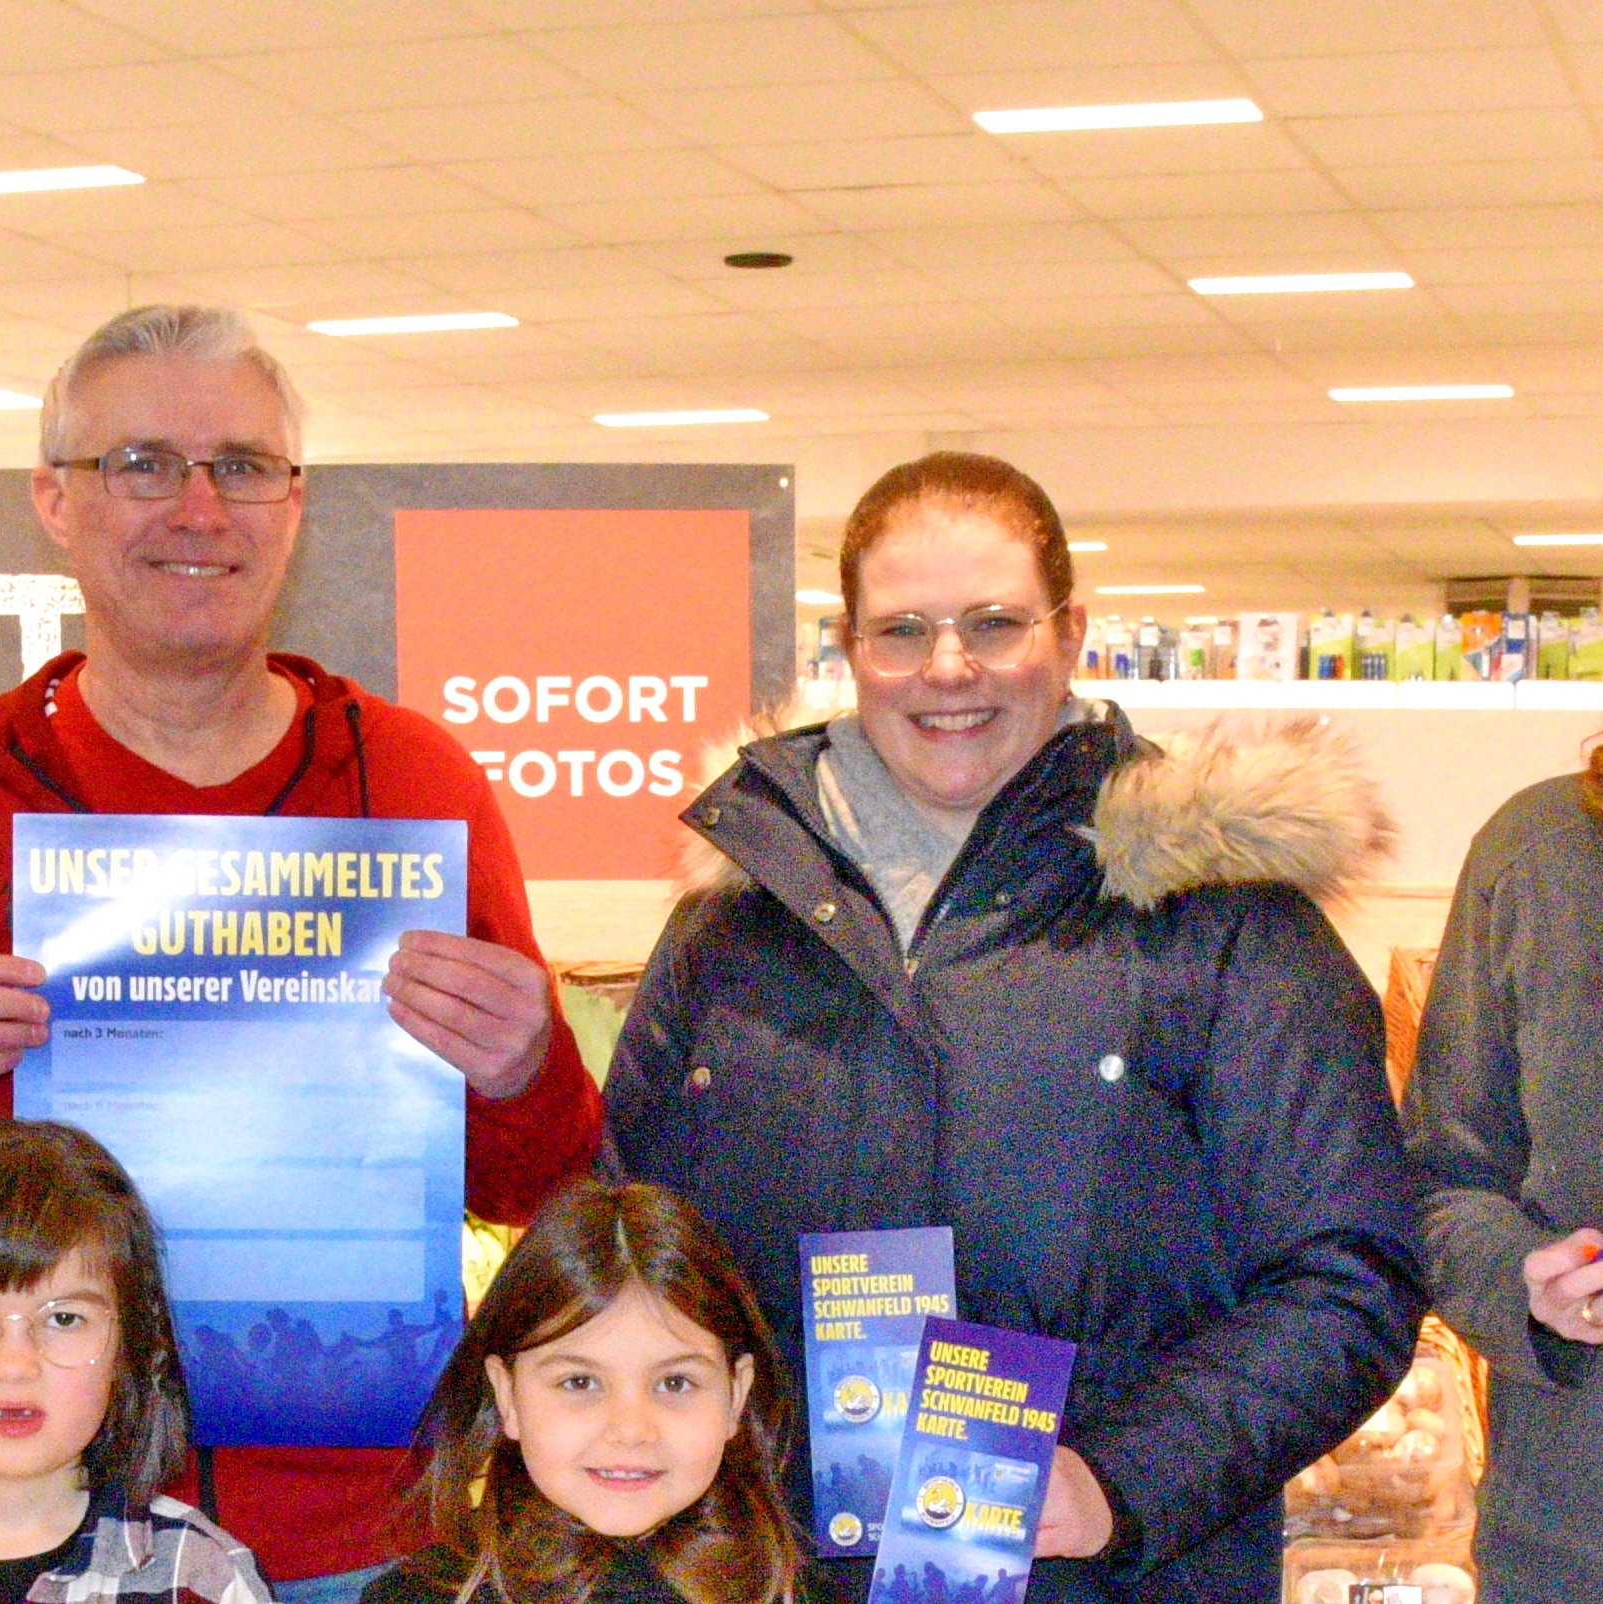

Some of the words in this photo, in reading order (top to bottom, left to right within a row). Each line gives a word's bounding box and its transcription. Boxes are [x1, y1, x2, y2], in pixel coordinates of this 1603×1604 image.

[442, 675, 709, 724] SOFORT
[170, 848, 444, 899] GESAMMELTES
[132, 910, 343, 957] GUTHABEN
[72, 975, 122, 1001] von
[129, 973, 233, 1002] unserer
[240, 969, 392, 1003] Vereinskar
[63, 1028, 92, 1038] nach
[95, 1028, 103, 1038] 3
[106, 1028, 165, 1039] Monaten:
[811, 1254, 869, 1274] UNSERE
[812, 1274, 914, 1297] SPORTVEREIN
[814, 1296, 912, 1319] SCHWANFELD
[914, 1294, 950, 1314] 1945
[815, 1321, 867, 1341] KARTE.
[929, 1341, 991, 1371] UNSERE
[925, 1364, 1029, 1403] SPORTVEREIN
[916, 1412, 969, 1440] KARTE.
[921, 1390, 1019, 1427] SCHWANFELD
[1021, 1408, 1057, 1434] 1945
